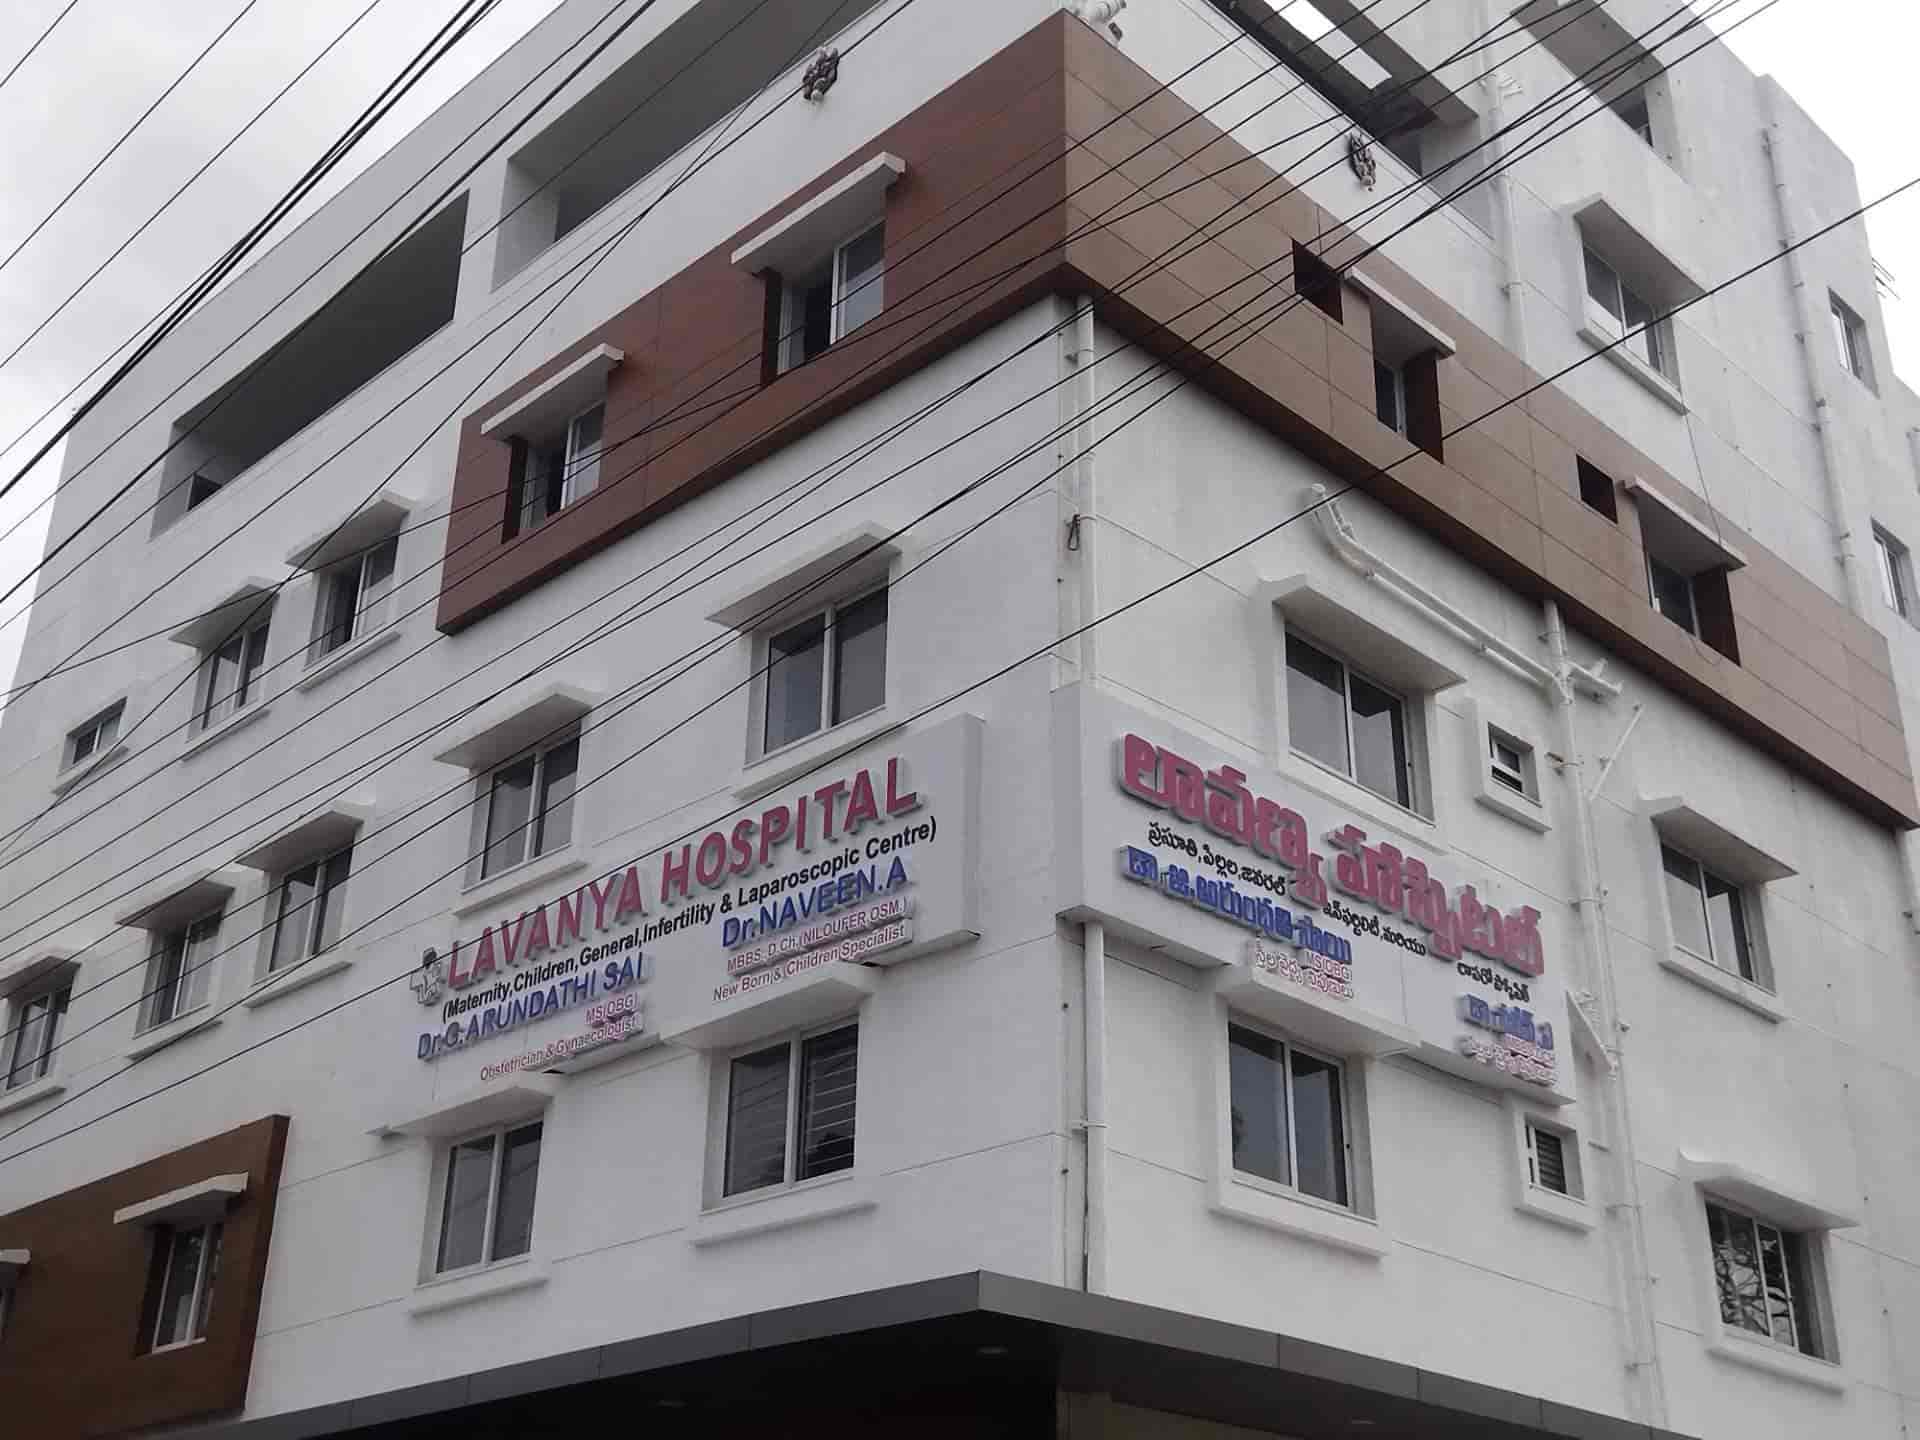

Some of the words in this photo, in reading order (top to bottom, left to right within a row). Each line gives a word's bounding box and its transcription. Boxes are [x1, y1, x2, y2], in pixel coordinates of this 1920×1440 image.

[1124, 733, 1328, 906] లావణ్య
[449, 866, 642, 989] LAVANYA
[661, 757, 917, 903] HOSPITAL
[720, 893, 732, 913] &
[738, 848, 859, 907] Laparoscopic
[866, 816, 937, 860] Centre)
[603, 952, 642, 992] SAI
[713, 984, 738, 1001] New
[742, 973, 770, 991] Born
[786, 947, 839, 975] Children
[841, 924, 905, 958] Specialist
[480, 1047, 542, 1081] Obstetrician
